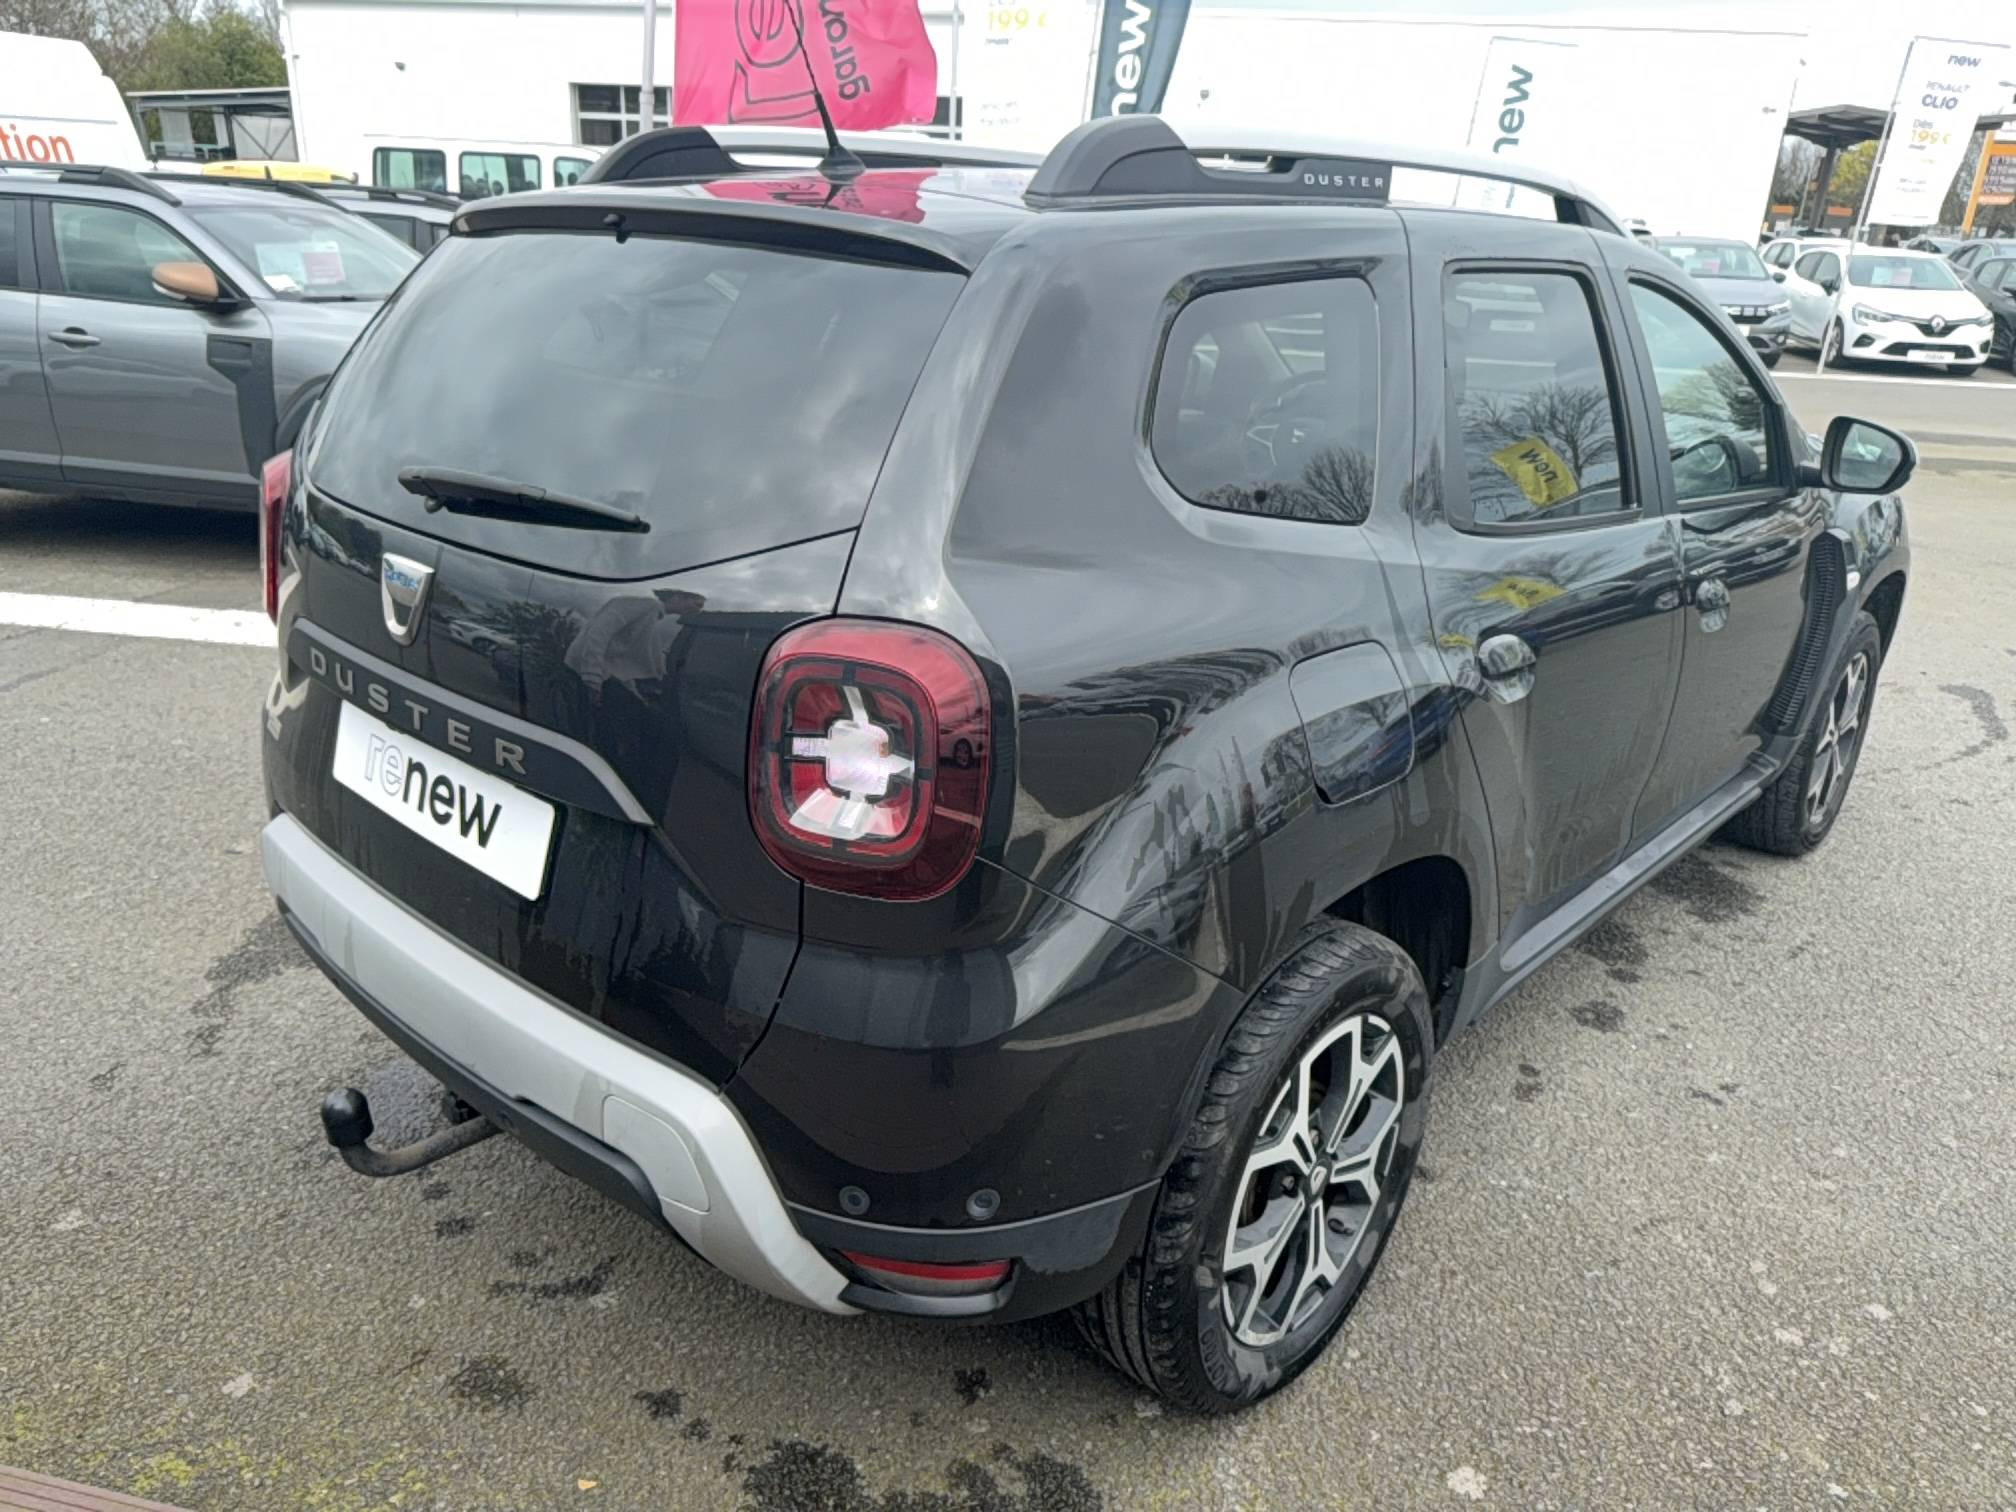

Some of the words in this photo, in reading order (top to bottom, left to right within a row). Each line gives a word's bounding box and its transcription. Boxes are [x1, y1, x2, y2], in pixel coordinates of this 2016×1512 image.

[1948, 54, 1981, 68] new
[1921, 94, 1959, 110] CLIO
[1303, 173, 1384, 189] DUSTER
[310, 647, 527, 775] DUSTER
[364, 733, 503, 849] renew
